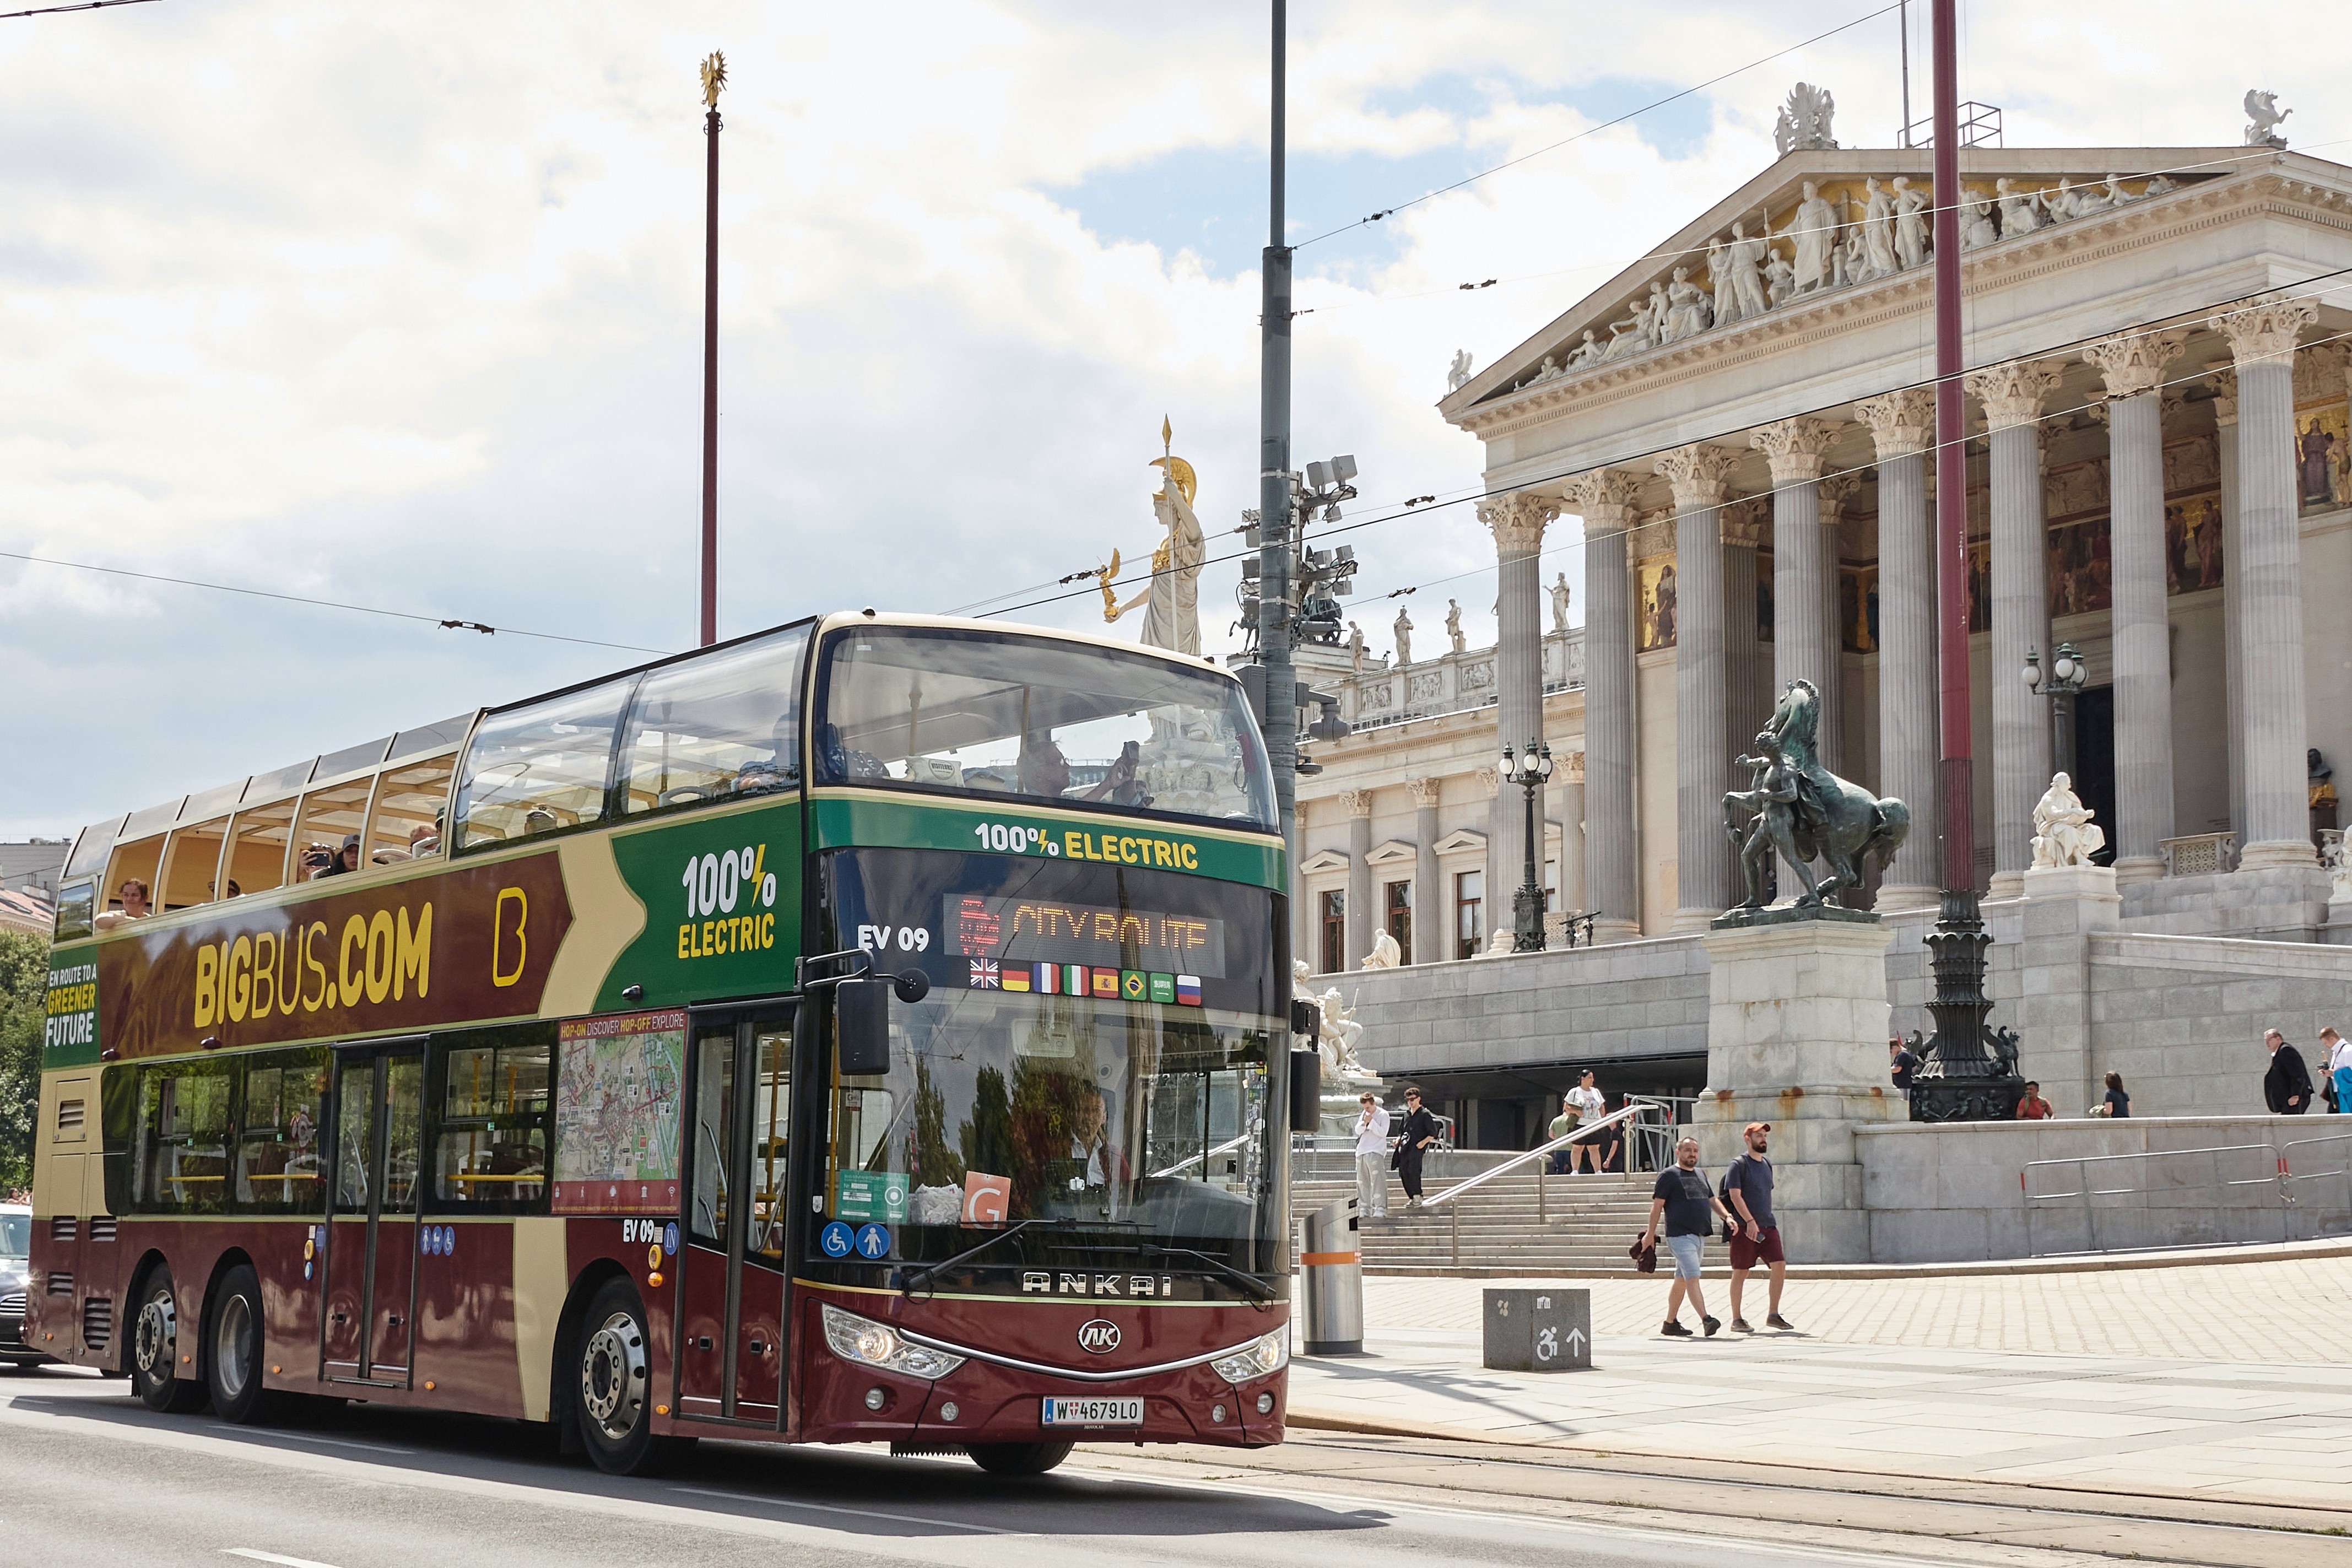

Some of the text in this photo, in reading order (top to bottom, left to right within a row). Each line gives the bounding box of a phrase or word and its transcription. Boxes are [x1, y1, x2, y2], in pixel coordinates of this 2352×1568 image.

[974, 823, 1198, 869] 100% ELECTRIC
[682, 844, 776, 918] 100%
[678, 912, 775, 959] ELECTRIC
[858, 924, 929, 952] EV 09
[49, 963, 97, 987] EN ROUTE TO A
[194, 901, 433, 1028] BIGBUS.COM
[48, 983, 95, 1015] GREENER
[45, 1012, 94, 1047] FUTURE
[561, 1013, 684, 1038] HOP-ON DISCOVER HOP-OFF EXPLORE
[969, 1187, 1001, 1230] G
[623, 1219, 638, 1242] EV
[640, 1219, 655, 1243] 09
[1022, 1272, 1171, 1296] ANKAI
